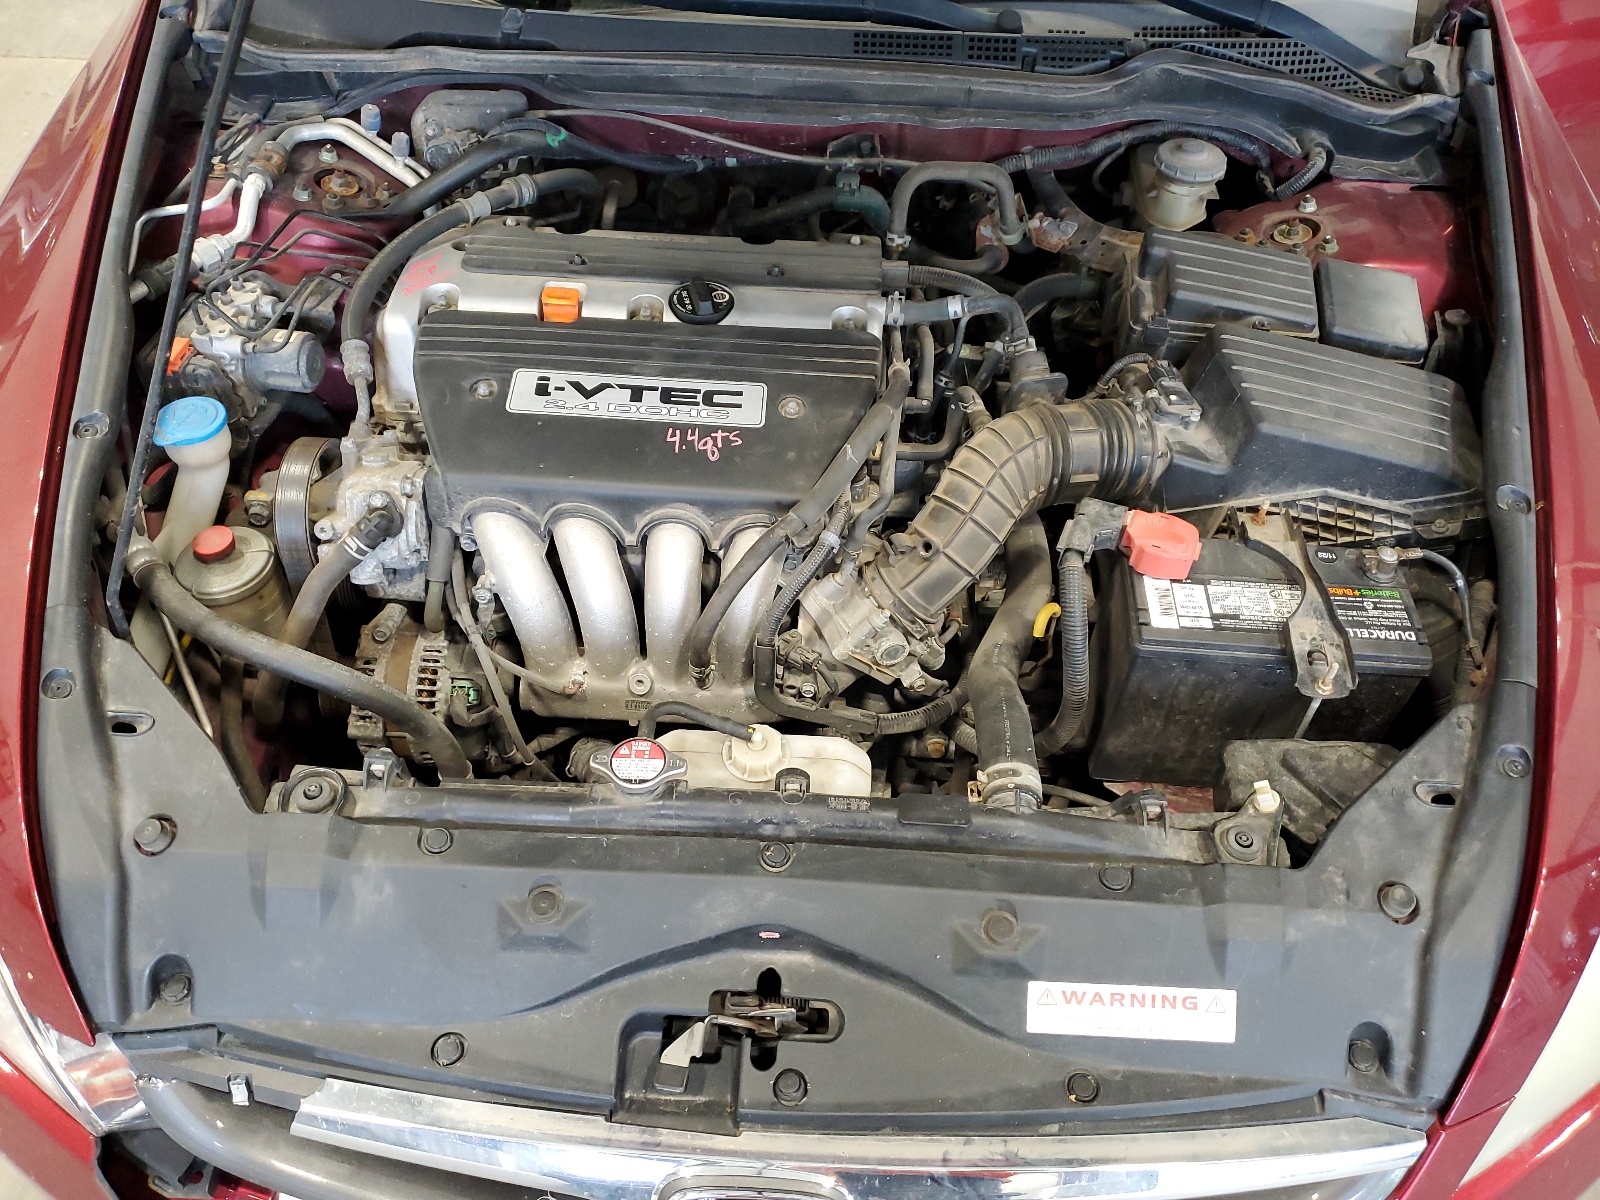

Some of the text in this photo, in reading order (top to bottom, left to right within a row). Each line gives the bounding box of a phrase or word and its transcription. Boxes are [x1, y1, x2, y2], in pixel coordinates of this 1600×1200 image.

[535, 375, 744, 408] i-VTEC
[543, 398, 730, 420] 2.4 DOHC
[1317, 551, 1337, 560] 11/22
[1346, 628, 1417, 640] DURACELL
[1061, 990, 1198, 1011] WARNING
